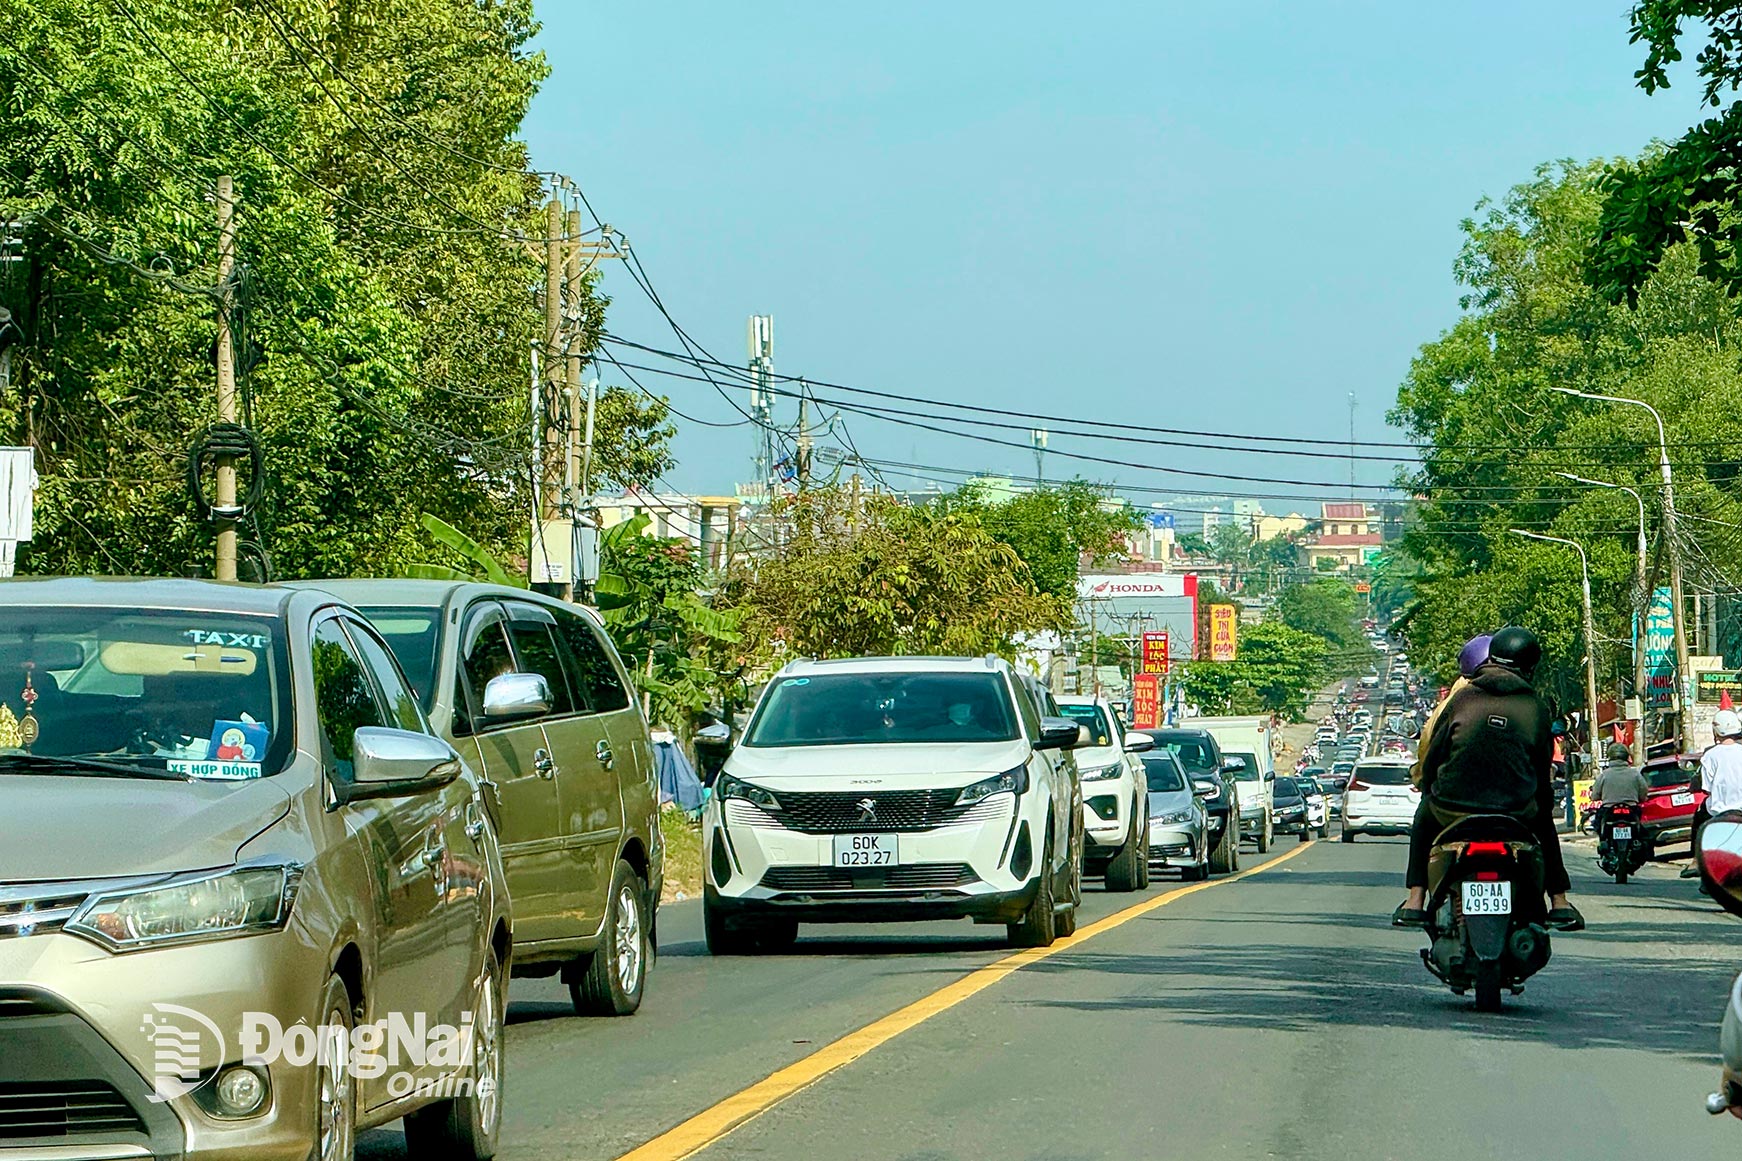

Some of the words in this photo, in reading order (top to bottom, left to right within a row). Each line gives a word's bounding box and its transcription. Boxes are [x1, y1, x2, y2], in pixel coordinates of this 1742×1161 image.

[1109, 584, 1164, 593] HONDA
[184, 629, 268, 648] TAXI
[1148, 641, 1165, 650] KIM
[1136, 688, 1154, 700] KIM
[170, 764, 187, 774] XE
[191, 764, 218, 777] HỢP
[852, 836, 880, 850] 60K
[841, 850, 892, 865] 023.27
[1469, 883, 1504, 897] 60-AA
[1465, 898, 1509, 912] 495.99
